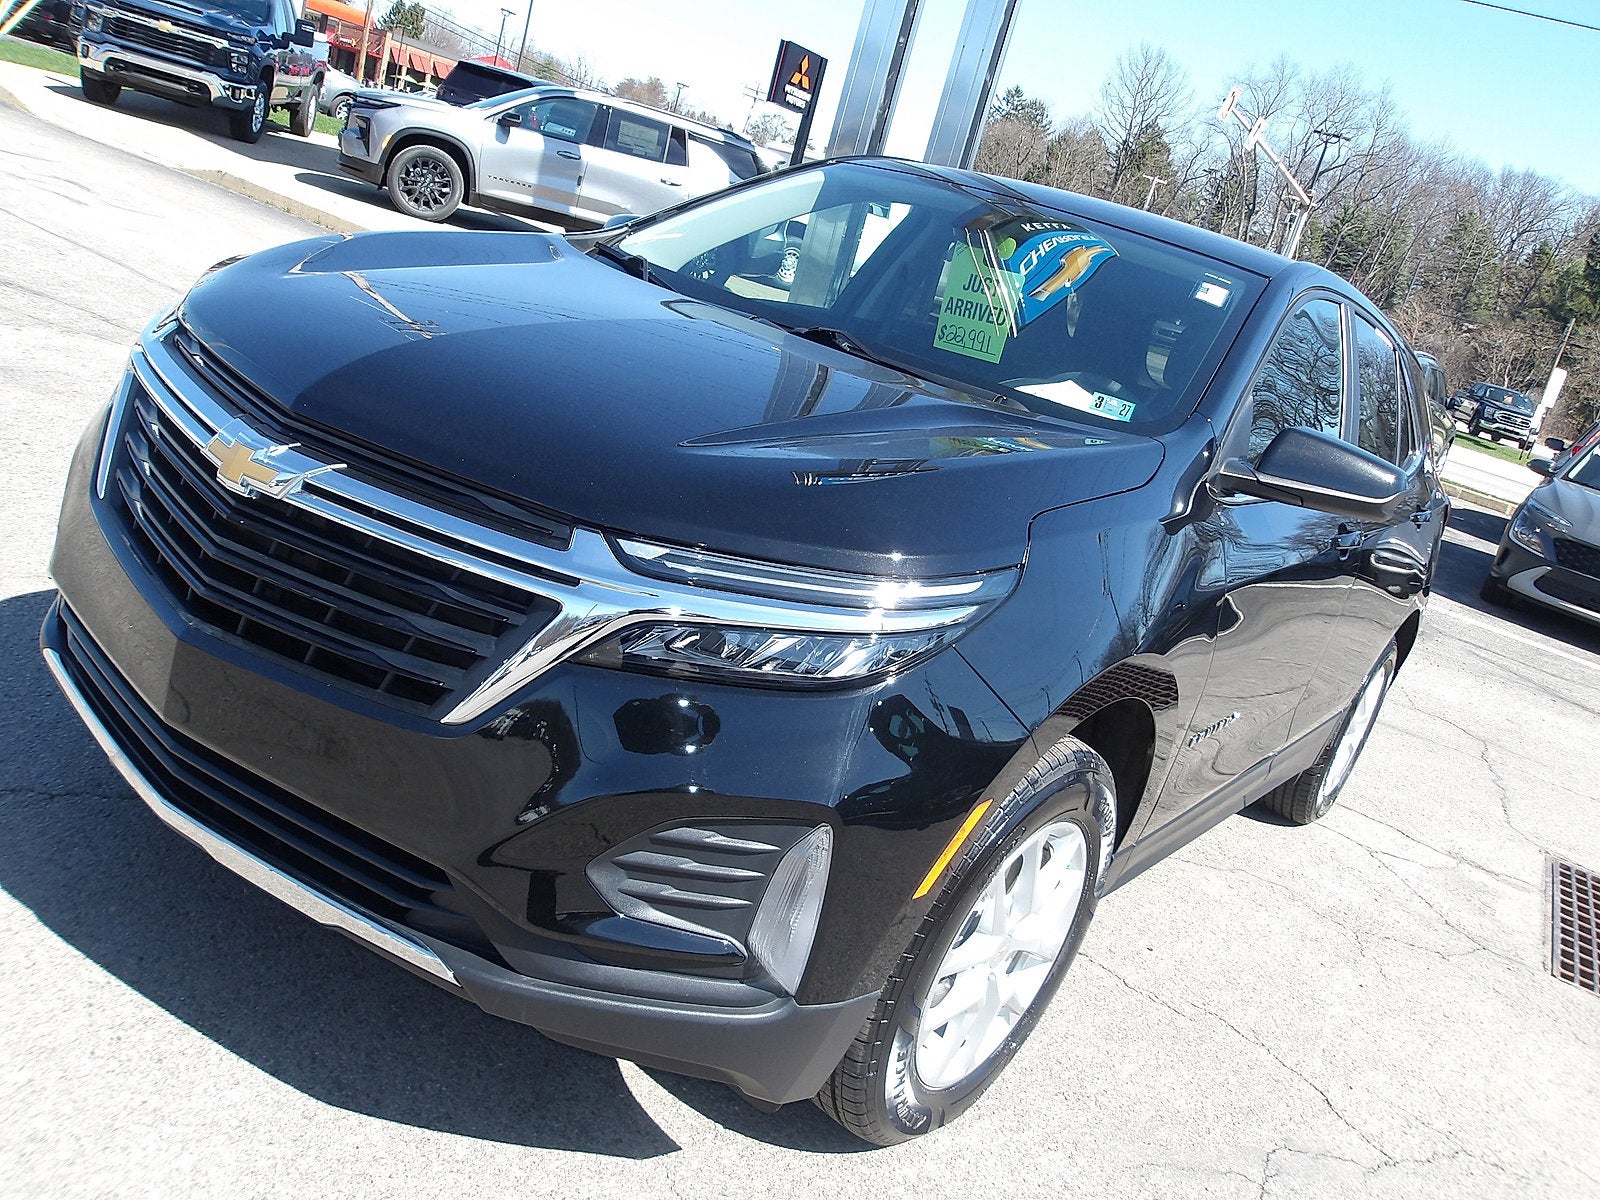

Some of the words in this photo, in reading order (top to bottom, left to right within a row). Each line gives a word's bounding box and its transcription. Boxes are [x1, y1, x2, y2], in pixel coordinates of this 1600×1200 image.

[962, 273, 1001, 297] JUST
[944, 296, 1007, 327] ARRIVED
[1094, 395, 1105, 409] 3
[1118, 403, 1132, 418] 27
